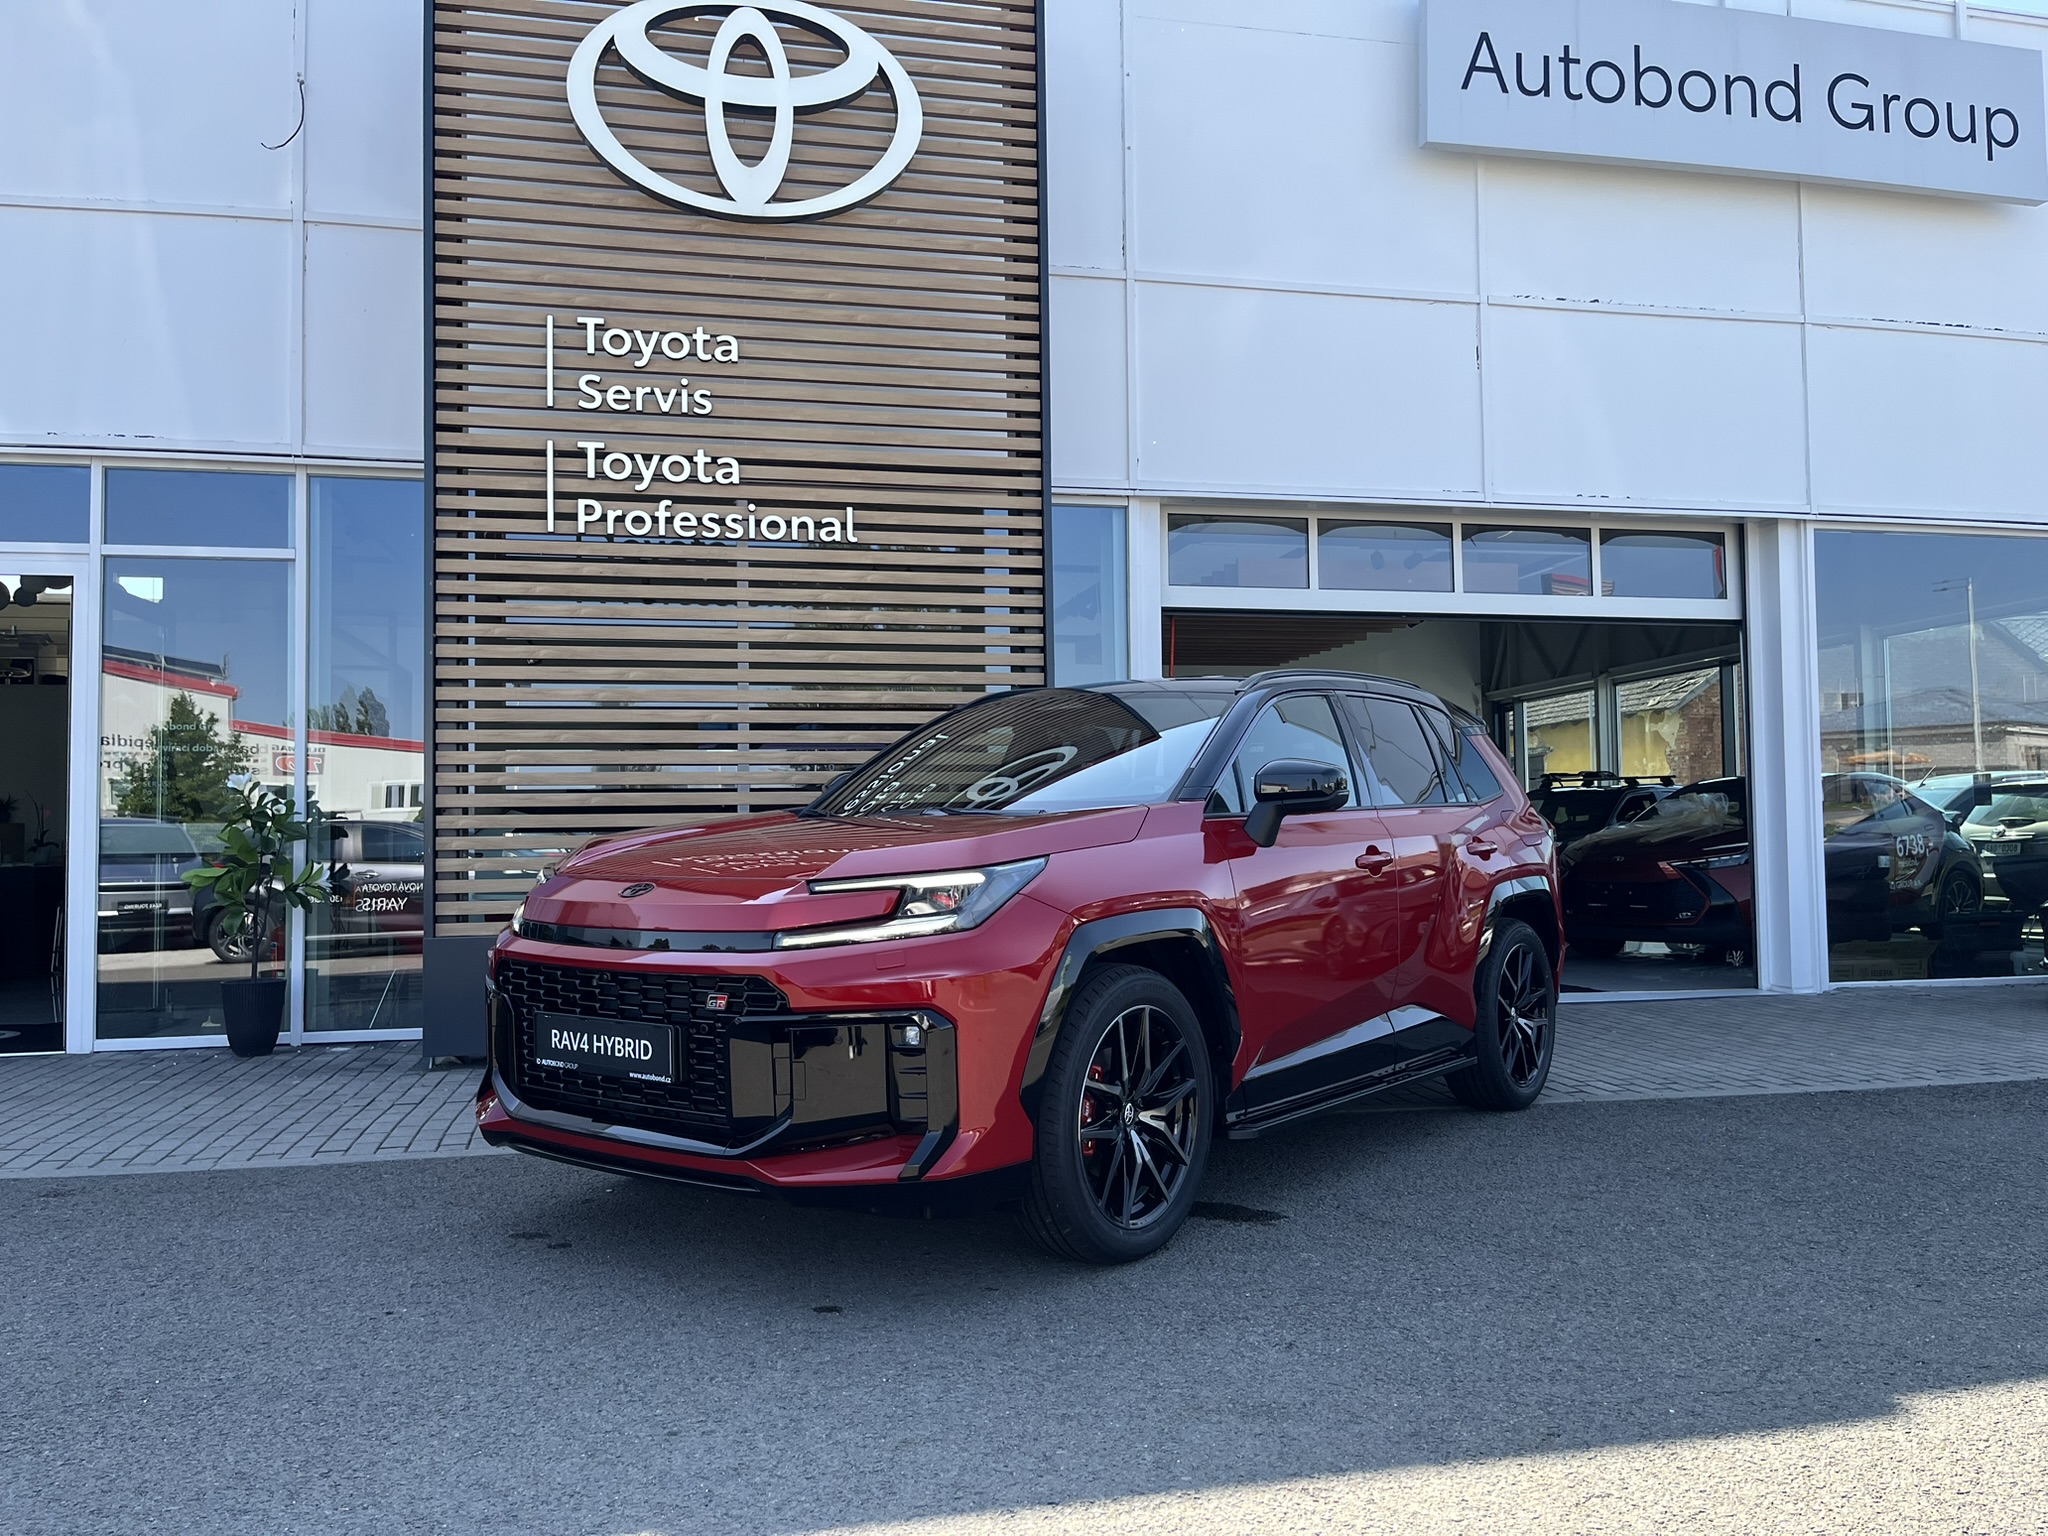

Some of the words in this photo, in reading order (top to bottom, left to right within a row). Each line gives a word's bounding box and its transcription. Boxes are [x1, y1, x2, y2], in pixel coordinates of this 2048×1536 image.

[1460, 31, 1802, 123] Autobond
[1827, 72, 2020, 162] Group
[576, 316, 739, 368] Toyota
[577, 373, 713, 415] Servis
[576, 441, 741, 492] Toyota
[576, 498, 858, 543] Professional
[708, 999, 726, 1009] GR
[541, 1058, 564, 1068] AUTOBOND
[564, 1062, 579, 1070] GROUP
[551, 1029, 589, 1053] RAV4
[593, 1034, 653, 1061] HYBRID
[629, 1071, 672, 1084] www.autobond.cz
